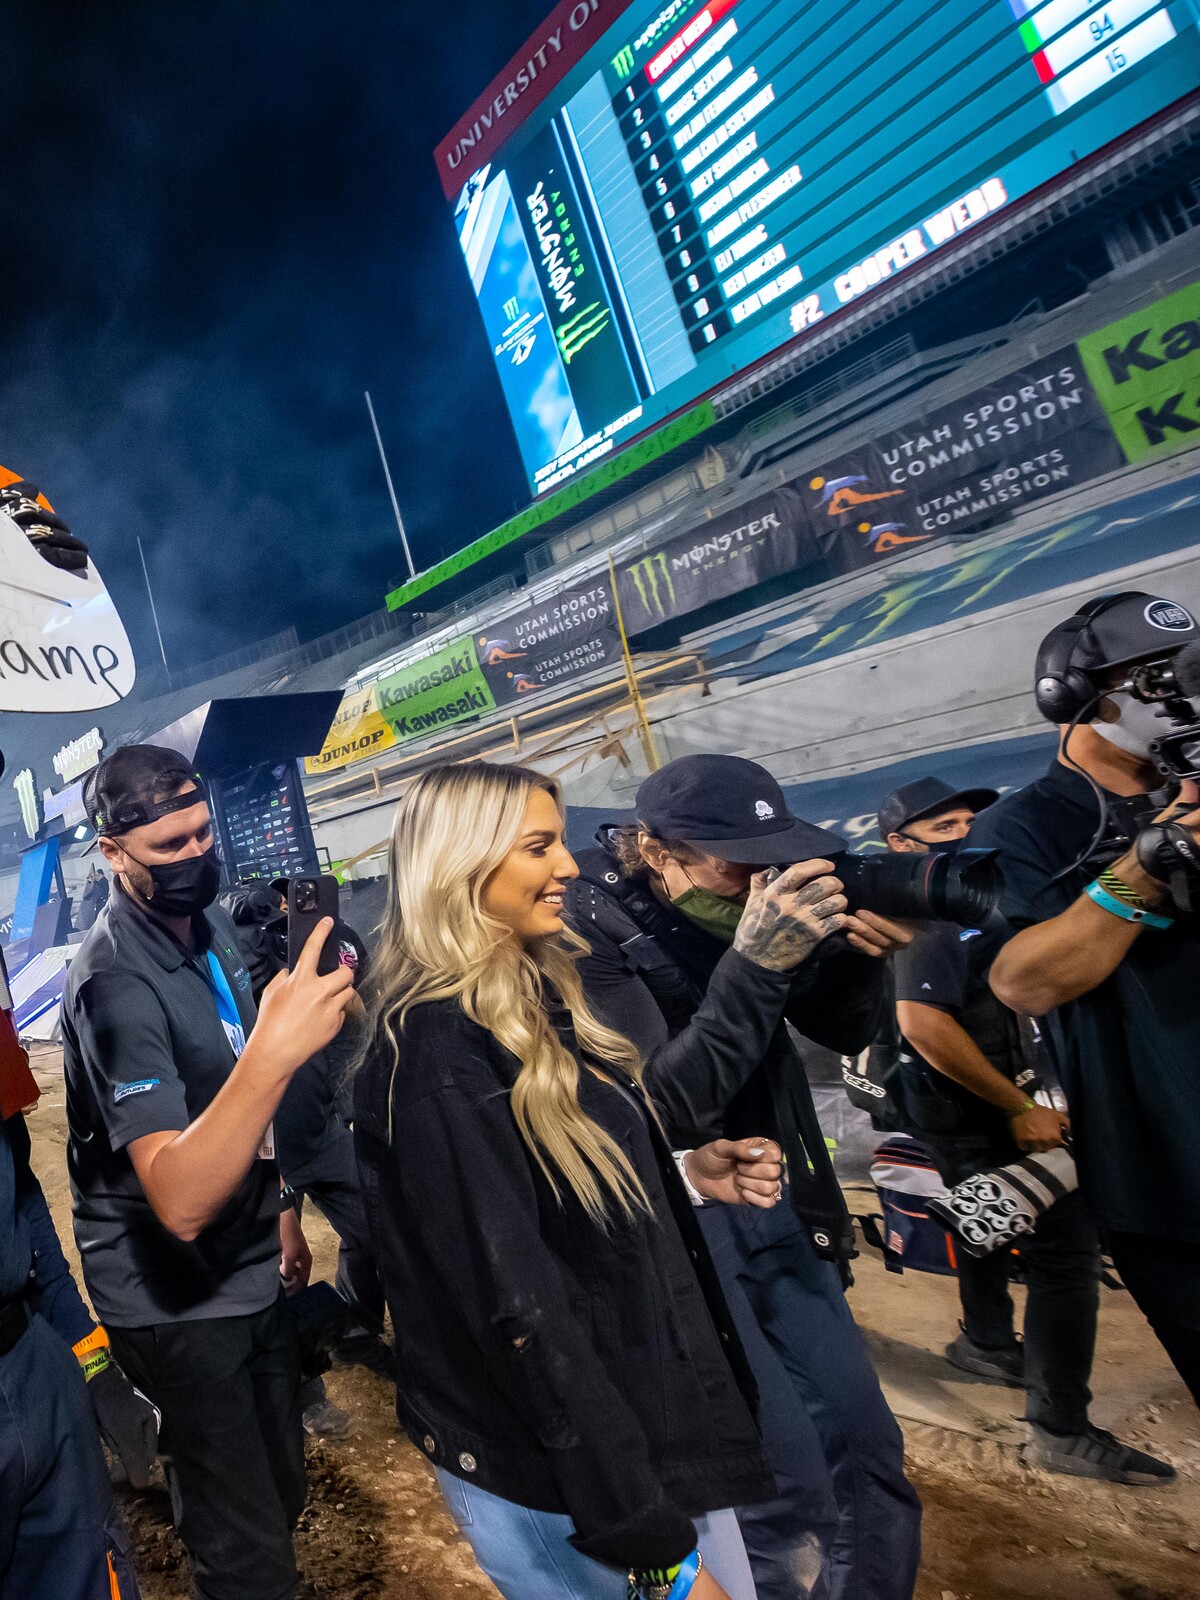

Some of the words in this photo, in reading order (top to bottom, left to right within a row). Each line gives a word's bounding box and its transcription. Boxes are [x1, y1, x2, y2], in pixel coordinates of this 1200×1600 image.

[1089, 13, 1115, 41] 94
[1105, 46, 1127, 73] 15
[447, 28, 564, 169] UNIVERSITY
[632, 108, 644, 127] 2
[640, 131, 652, 149] 3
[655, 177, 668, 197] 5
[526, 181, 577, 313] MONSTER
[671, 225, 682, 244] 7
[789, 293, 826, 334] #2
[833, 228, 928, 302] COOPER
[1102, 316, 1200, 386] Ka
[882, 424, 952, 466] UTAH
[962, 366, 1076, 430] SPORTS
[889, 387, 1084, 484] COMMISSION
[1136, 391, 1200, 446] K
[916, 486, 972, 517] UTAH
[978, 448, 1065, 493] SPORTS
[922, 464, 1070, 531] COMMISSION
[671, 512, 782, 571] MONSTER
[692, 537, 766, 577] ENERGY
[515, 613, 549, 636] UTAH
[553, 586, 606, 619] SPORTS
[519, 601, 610, 649] COMMISSION
[535, 656, 562, 673] UTAH
[563, 638, 603, 661] SPORTS
[539, 649, 607, 682] COMMISSION
[379, 651, 474, 710] Kawasaki
[332, 699, 372, 727] NLOP
[395, 686, 489, 737] Kawasaki
[53, 729, 103, 772] MONSTER
[321, 729, 385, 764] DUNLOP
